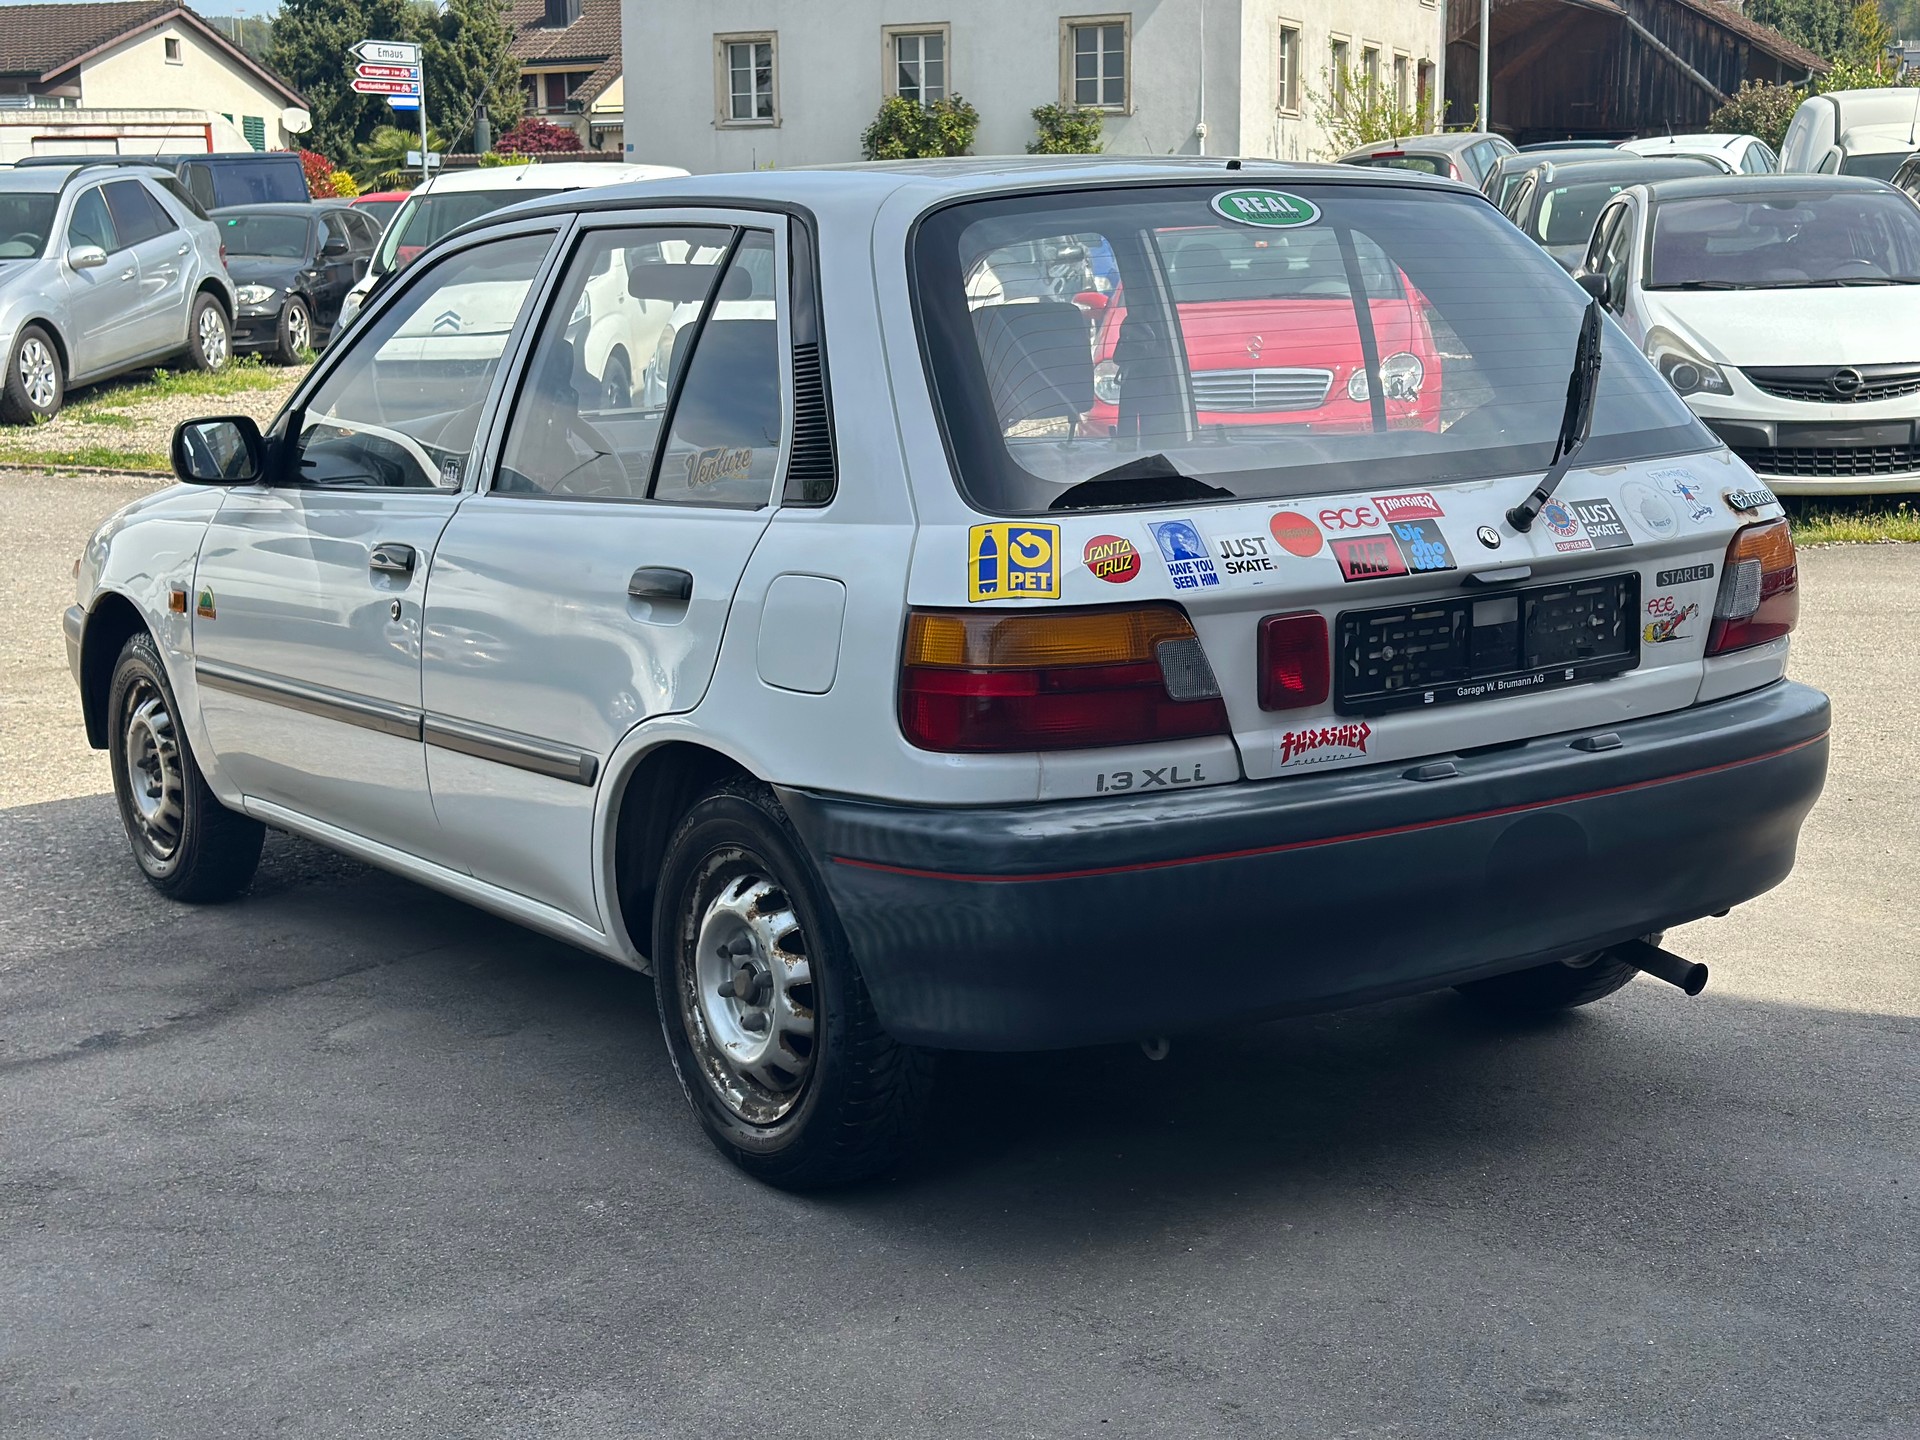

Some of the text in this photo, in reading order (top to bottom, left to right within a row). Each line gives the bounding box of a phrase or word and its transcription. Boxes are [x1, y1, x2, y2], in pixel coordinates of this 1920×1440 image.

[377, 47, 404, 59] Emaus
[1230, 196, 1299, 213] REAL
[686, 447, 751, 489] Venture
[1376, 495, 1438, 516] THRASHER
[1577, 504, 1617, 524] JUST
[1318, 507, 1380, 530] ACE
[1547, 518, 1578, 536] PERALTA
[1083, 539, 1131, 563] SANTA
[1219, 537, 1269, 559] JUST
[1557, 540, 1590, 551] SUPREME
[1096, 555, 1133, 578] CRUZ
[1167, 559, 1214, 576] HAVE YOU
[1662, 565, 1710, 585] STARLET
[1009, 572, 1051, 589] PET
[1173, 572, 1220, 590] SEEN HIM
[1648, 596, 1675, 615] ACE
[1457, 674, 1545, 696] Garage W. Brumann AG
[1280, 722, 1372, 765] THRASHER
[1096, 763, 1206, 792] 1.3 XLi
